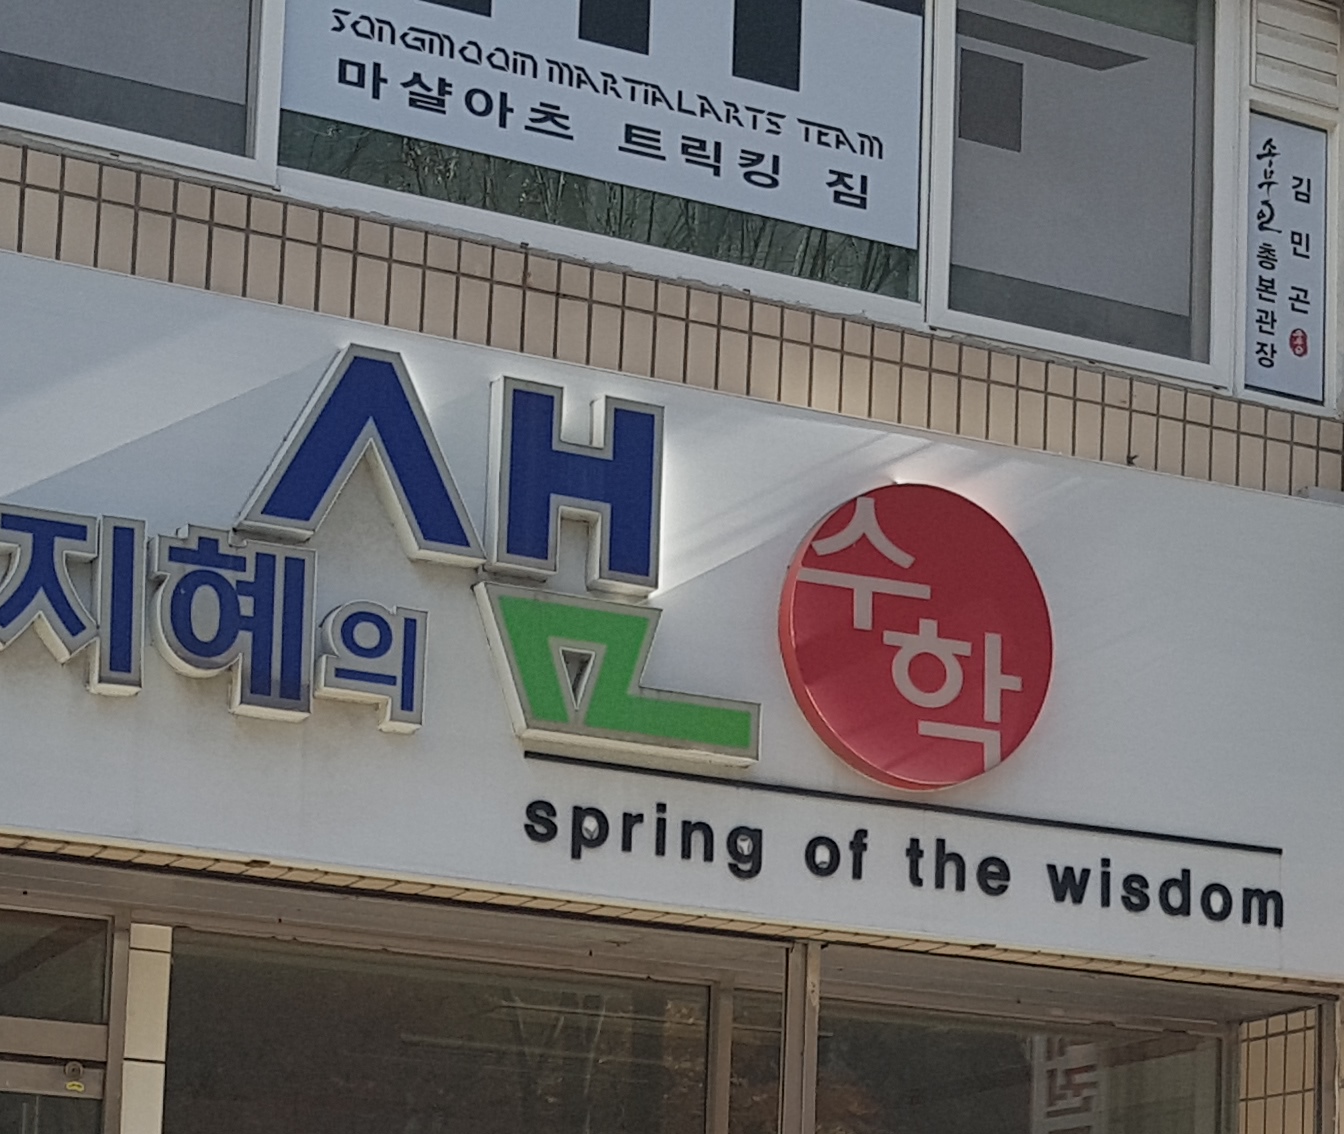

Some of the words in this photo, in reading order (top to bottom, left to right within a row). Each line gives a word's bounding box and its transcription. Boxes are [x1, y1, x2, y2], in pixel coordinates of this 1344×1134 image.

[337, 58, 574, 141] 마샬아츠
[618, 123, 780, 190] 트릭킹
[825, 168, 868, 210] 짐
[796, 117, 884, 160] TEAM
[234, 345, 763, 768] 샘
[792, 494, 1026, 766] 수학
[523, 795, 766, 880] spring
[803, 826, 869, 880] of
[905, 835, 1011, 900] the
[1046, 848, 1287, 932] wisdom
